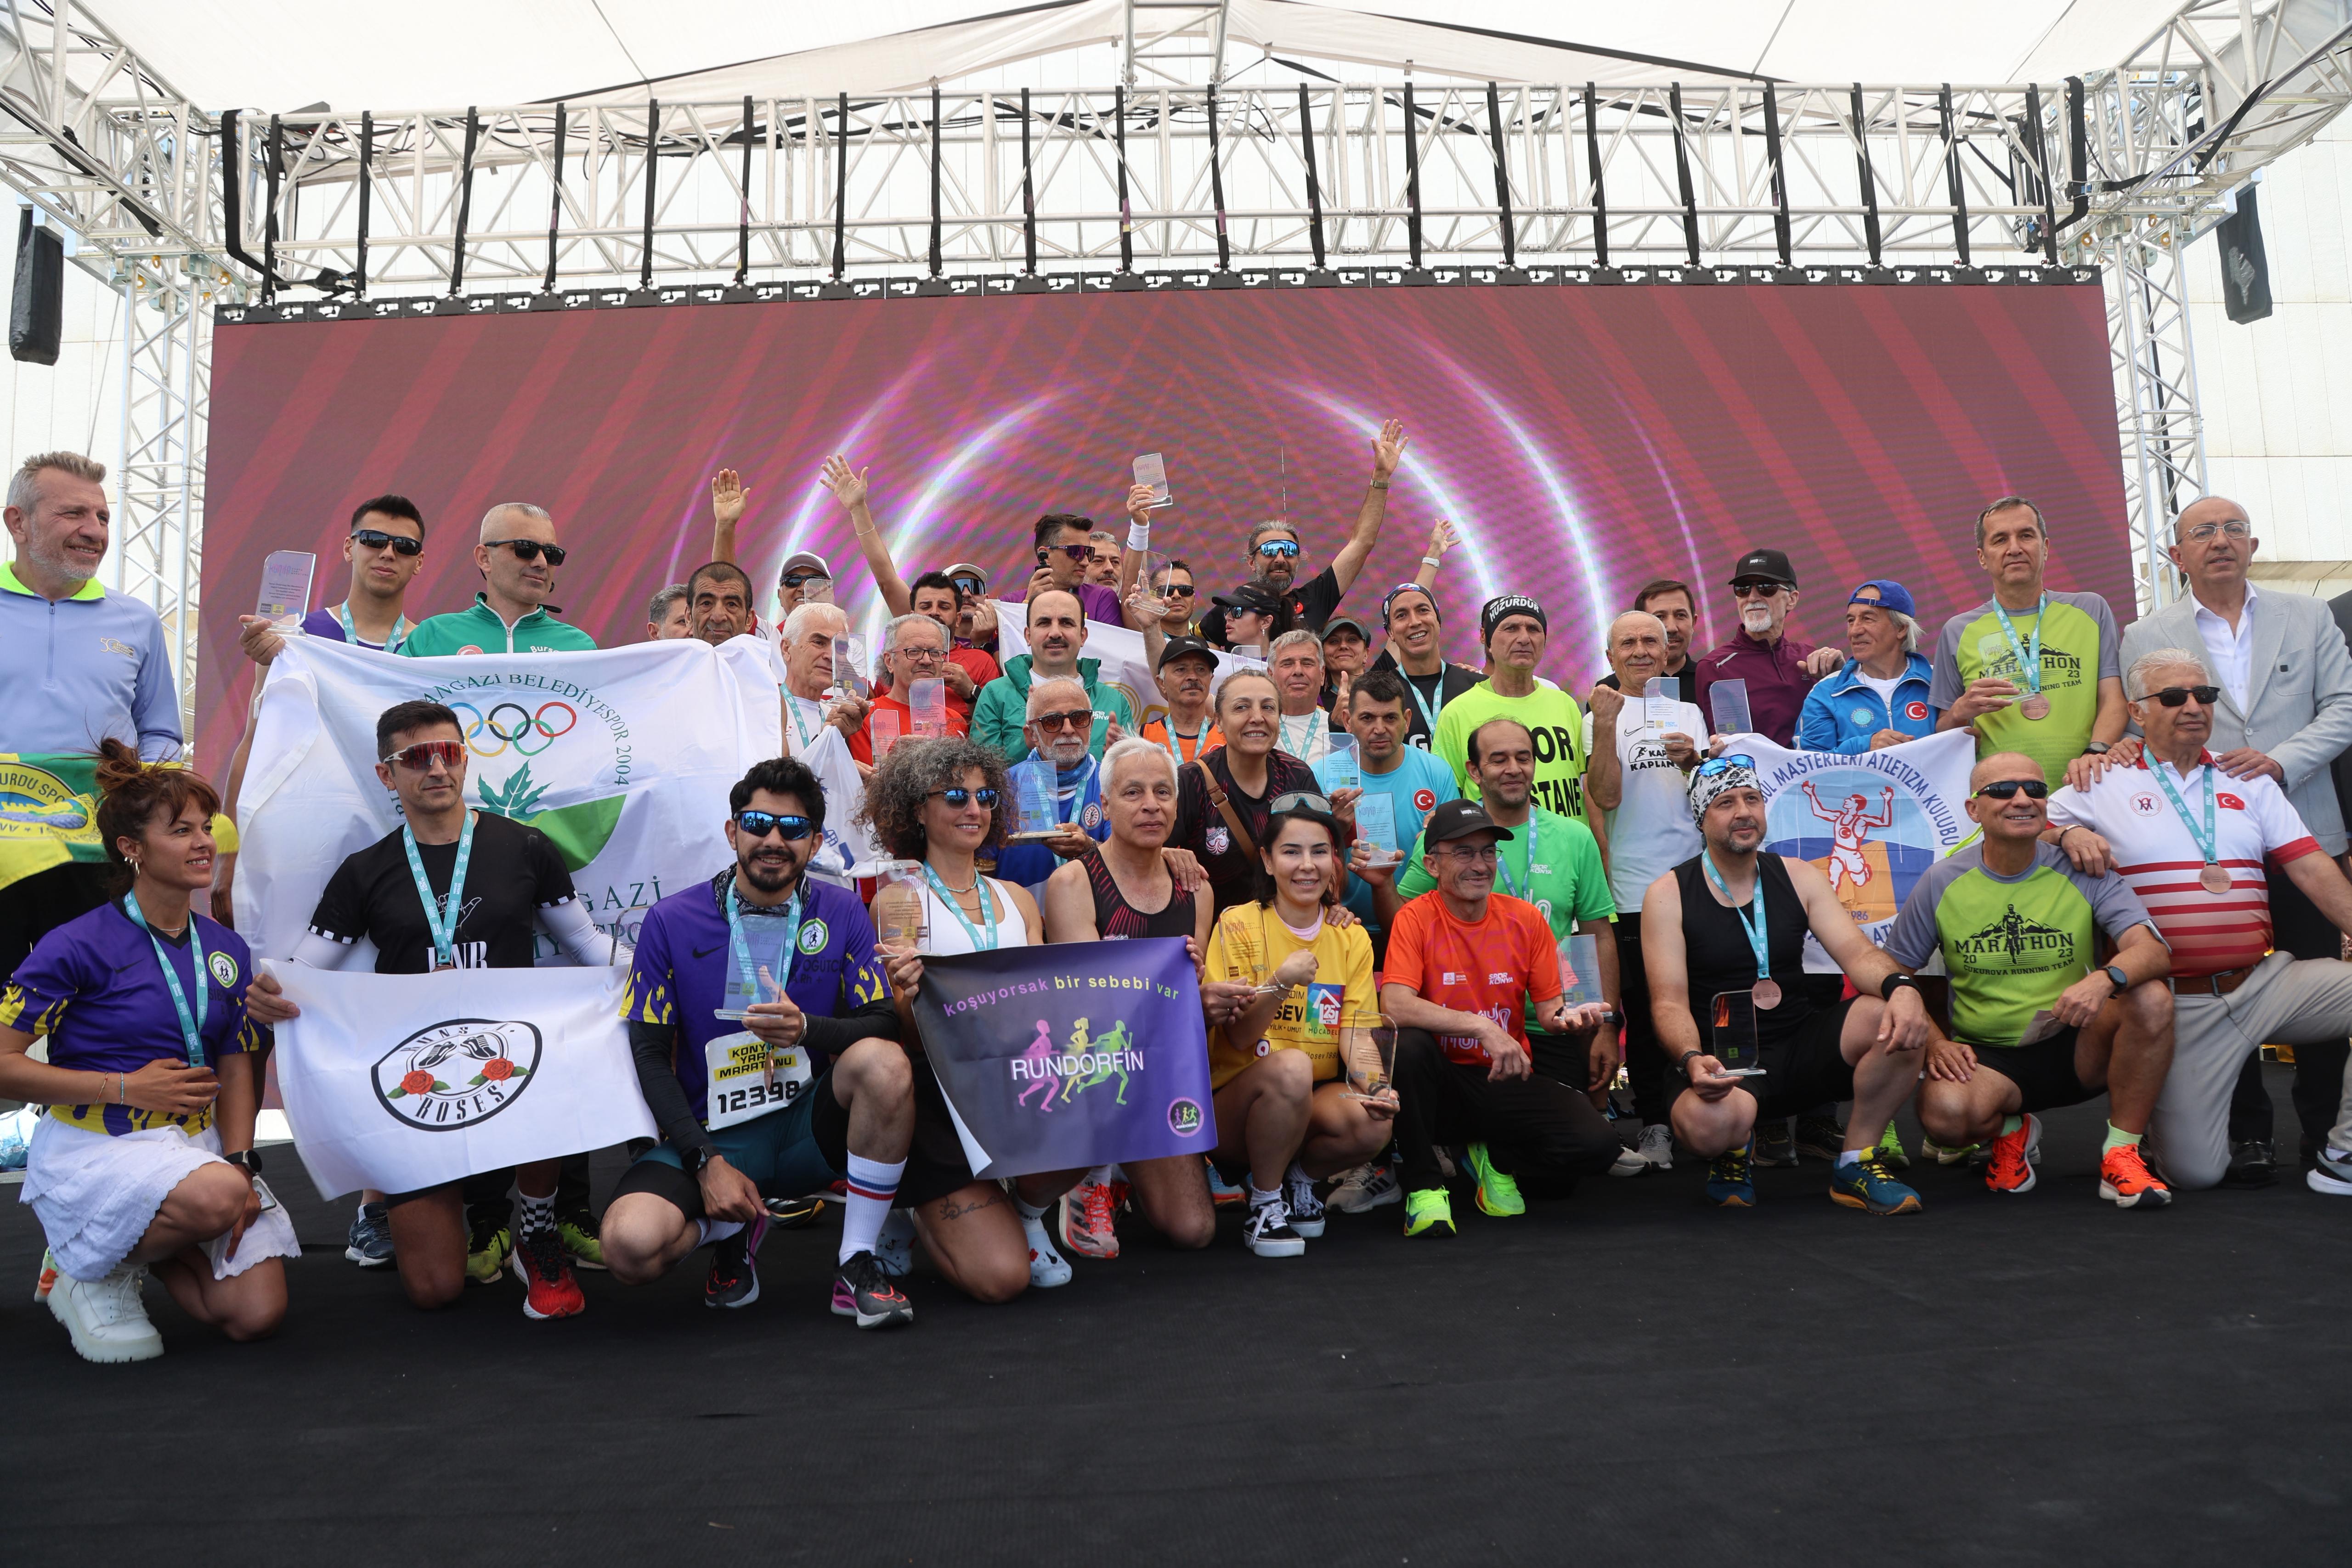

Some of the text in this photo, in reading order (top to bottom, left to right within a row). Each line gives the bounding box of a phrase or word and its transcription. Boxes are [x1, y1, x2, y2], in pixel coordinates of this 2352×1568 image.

[1489, 598, 1540, 622] HUZURDUR
[2067, 669, 2080, 678] 23
[2062, 679, 2082, 688] TEAM
[508, 673, 629, 743] BELEDİYESPOR
[614, 745, 632, 787] 2004
[1630, 760, 1676, 772] KAPLAN
[1866, 752, 1930, 798] ATLETIZM
[1922, 793, 1961, 846] KULUBU
[1847, 910, 1869, 921] 986
[1954, 932, 2075, 953] MARATHON
[1963, 948, 2074, 964] 20 23
[2011, 965, 2050, 975] RUNNING
[2052, 957, 2076, 970] TEAM
[1488, 972, 1508, 980] SPOR
[1489, 976, 1513, 985] KONYA
[943, 975, 1180, 1017] koşuyorsak bir sebebi var
[1308, 1027, 1340, 1036] MÜCADEL
[732, 1042, 775, 1058] KONY
[719, 1057, 792, 1078] MARATNU
[1011, 1047, 1145, 1081] RUNDORFİN
[414, 1084, 506, 1122] ROSES
[717, 1080, 801, 1115] 12398
